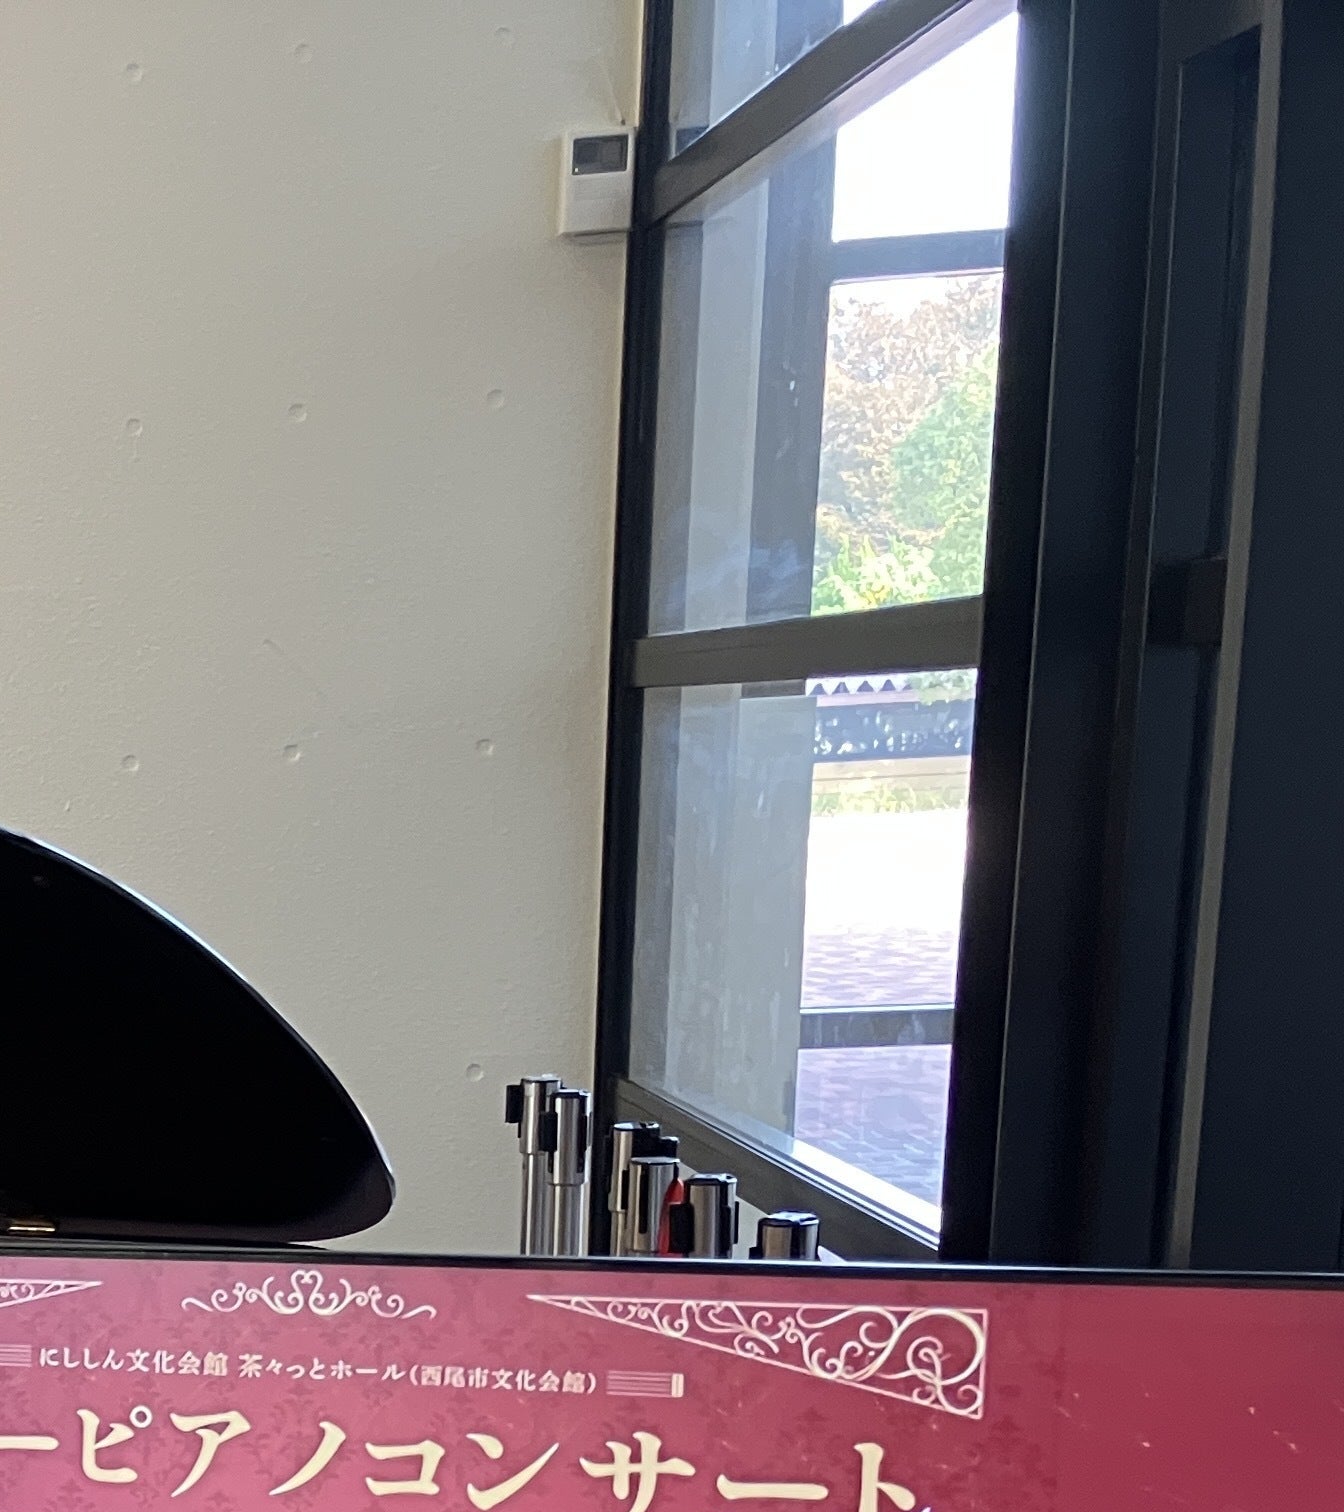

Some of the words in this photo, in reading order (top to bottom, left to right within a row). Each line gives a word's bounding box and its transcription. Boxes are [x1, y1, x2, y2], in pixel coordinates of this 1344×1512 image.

[40, 1346, 227, 1377] にししん文化会館
